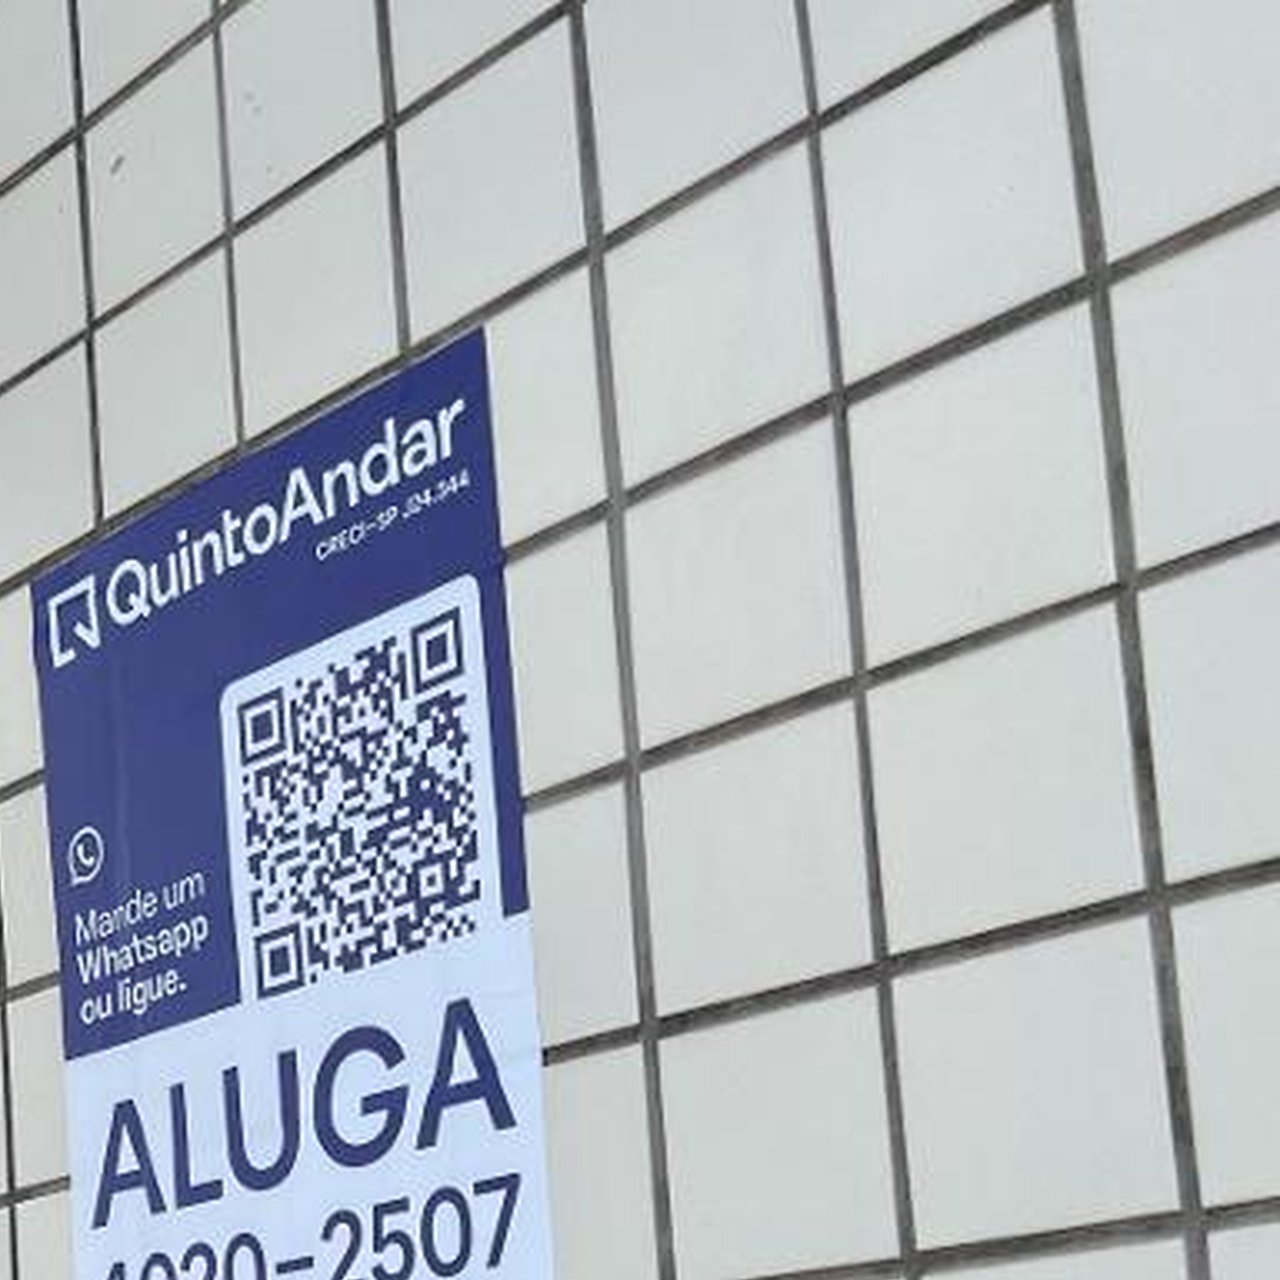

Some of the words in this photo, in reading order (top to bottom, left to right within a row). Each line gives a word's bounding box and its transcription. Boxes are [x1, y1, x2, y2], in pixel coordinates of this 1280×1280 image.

[106, 398, 466, 628] QuintoAndar
[75, 889, 159, 946] Mande
[162, 872, 205, 911] um
[76, 915, 209, 985] Whatsapp
[80, 992, 113, 1025] ou
[117, 969, 188, 1016] ligue.
[91, 997, 518, 1230] ALUGA
